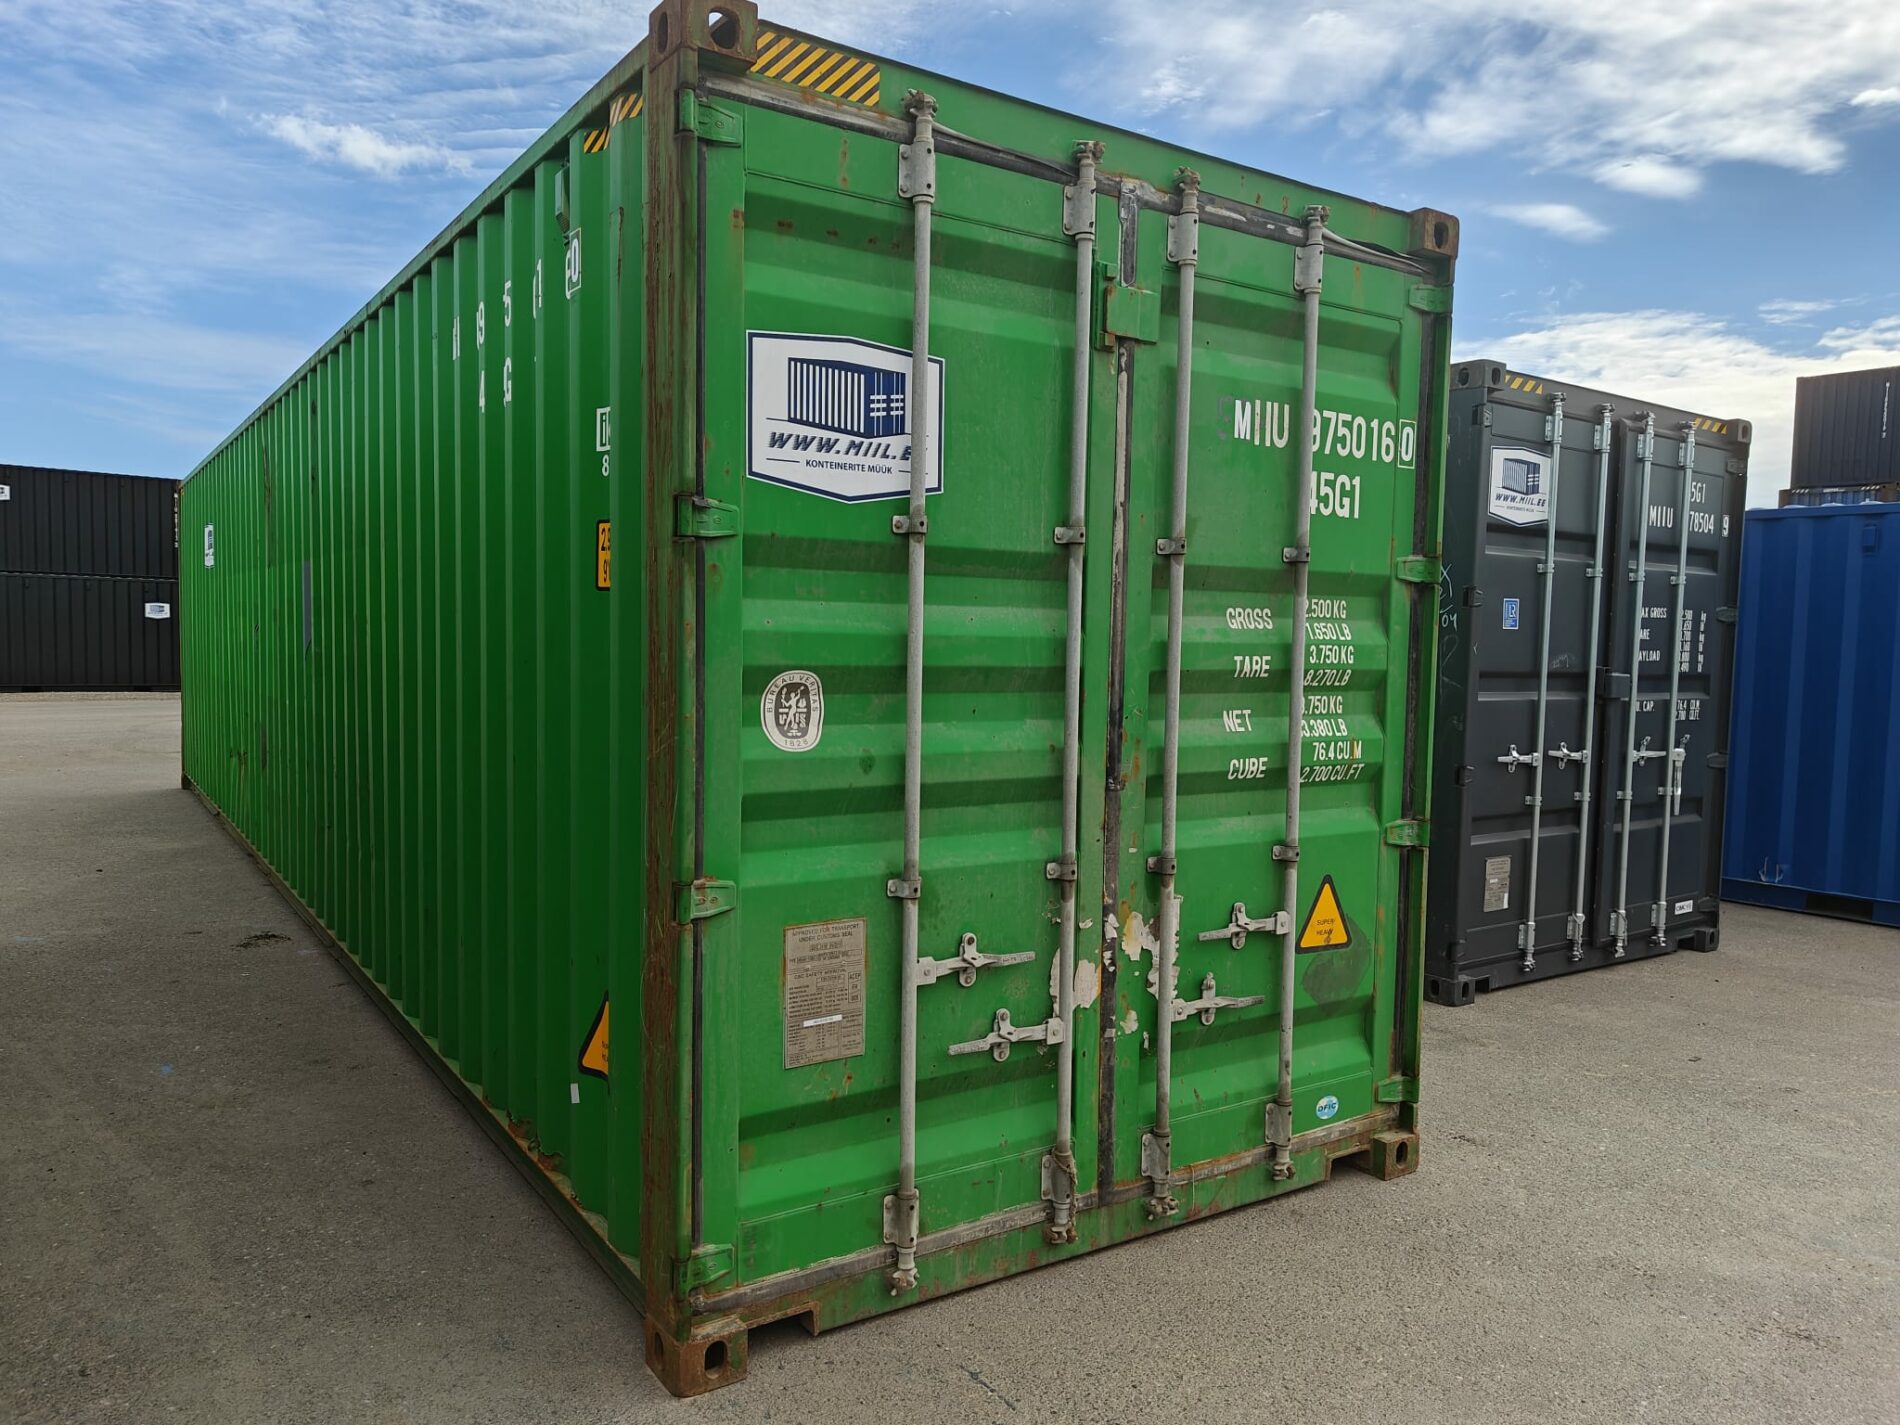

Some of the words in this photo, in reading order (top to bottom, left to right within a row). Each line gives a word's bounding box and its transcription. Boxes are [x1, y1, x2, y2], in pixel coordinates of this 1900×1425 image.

[1234, 399, 1290, 449] MIIU
[768, 431, 912, 461] WWW.MIIL.E
[805, 459, 866, 472] KONTEINERITE
[867, 463, 893, 475] MÜÜK
[1649, 505, 1674, 529] MIIU
[1226, 607, 1274, 630] GROSS
[1333, 599, 1347, 619] KG
[1650, 607, 1667, 618] GROSS
[1335, 623, 1352, 640] LB
[1233, 656, 1272, 678] TARE
[1309, 645, 1339, 665] 3.750
[1340, 645, 1354, 665] KG
[1304, 669, 1337, 687] 8.270
[1333, 669, 1352, 687] LB
[1223, 709, 1252, 733] NET
[1329, 695, 1343, 714] KG
[1331, 718, 1348, 737] LB
[1227, 757, 1268, 781] CUBE
[1313, 741, 1335, 761] 76.4
